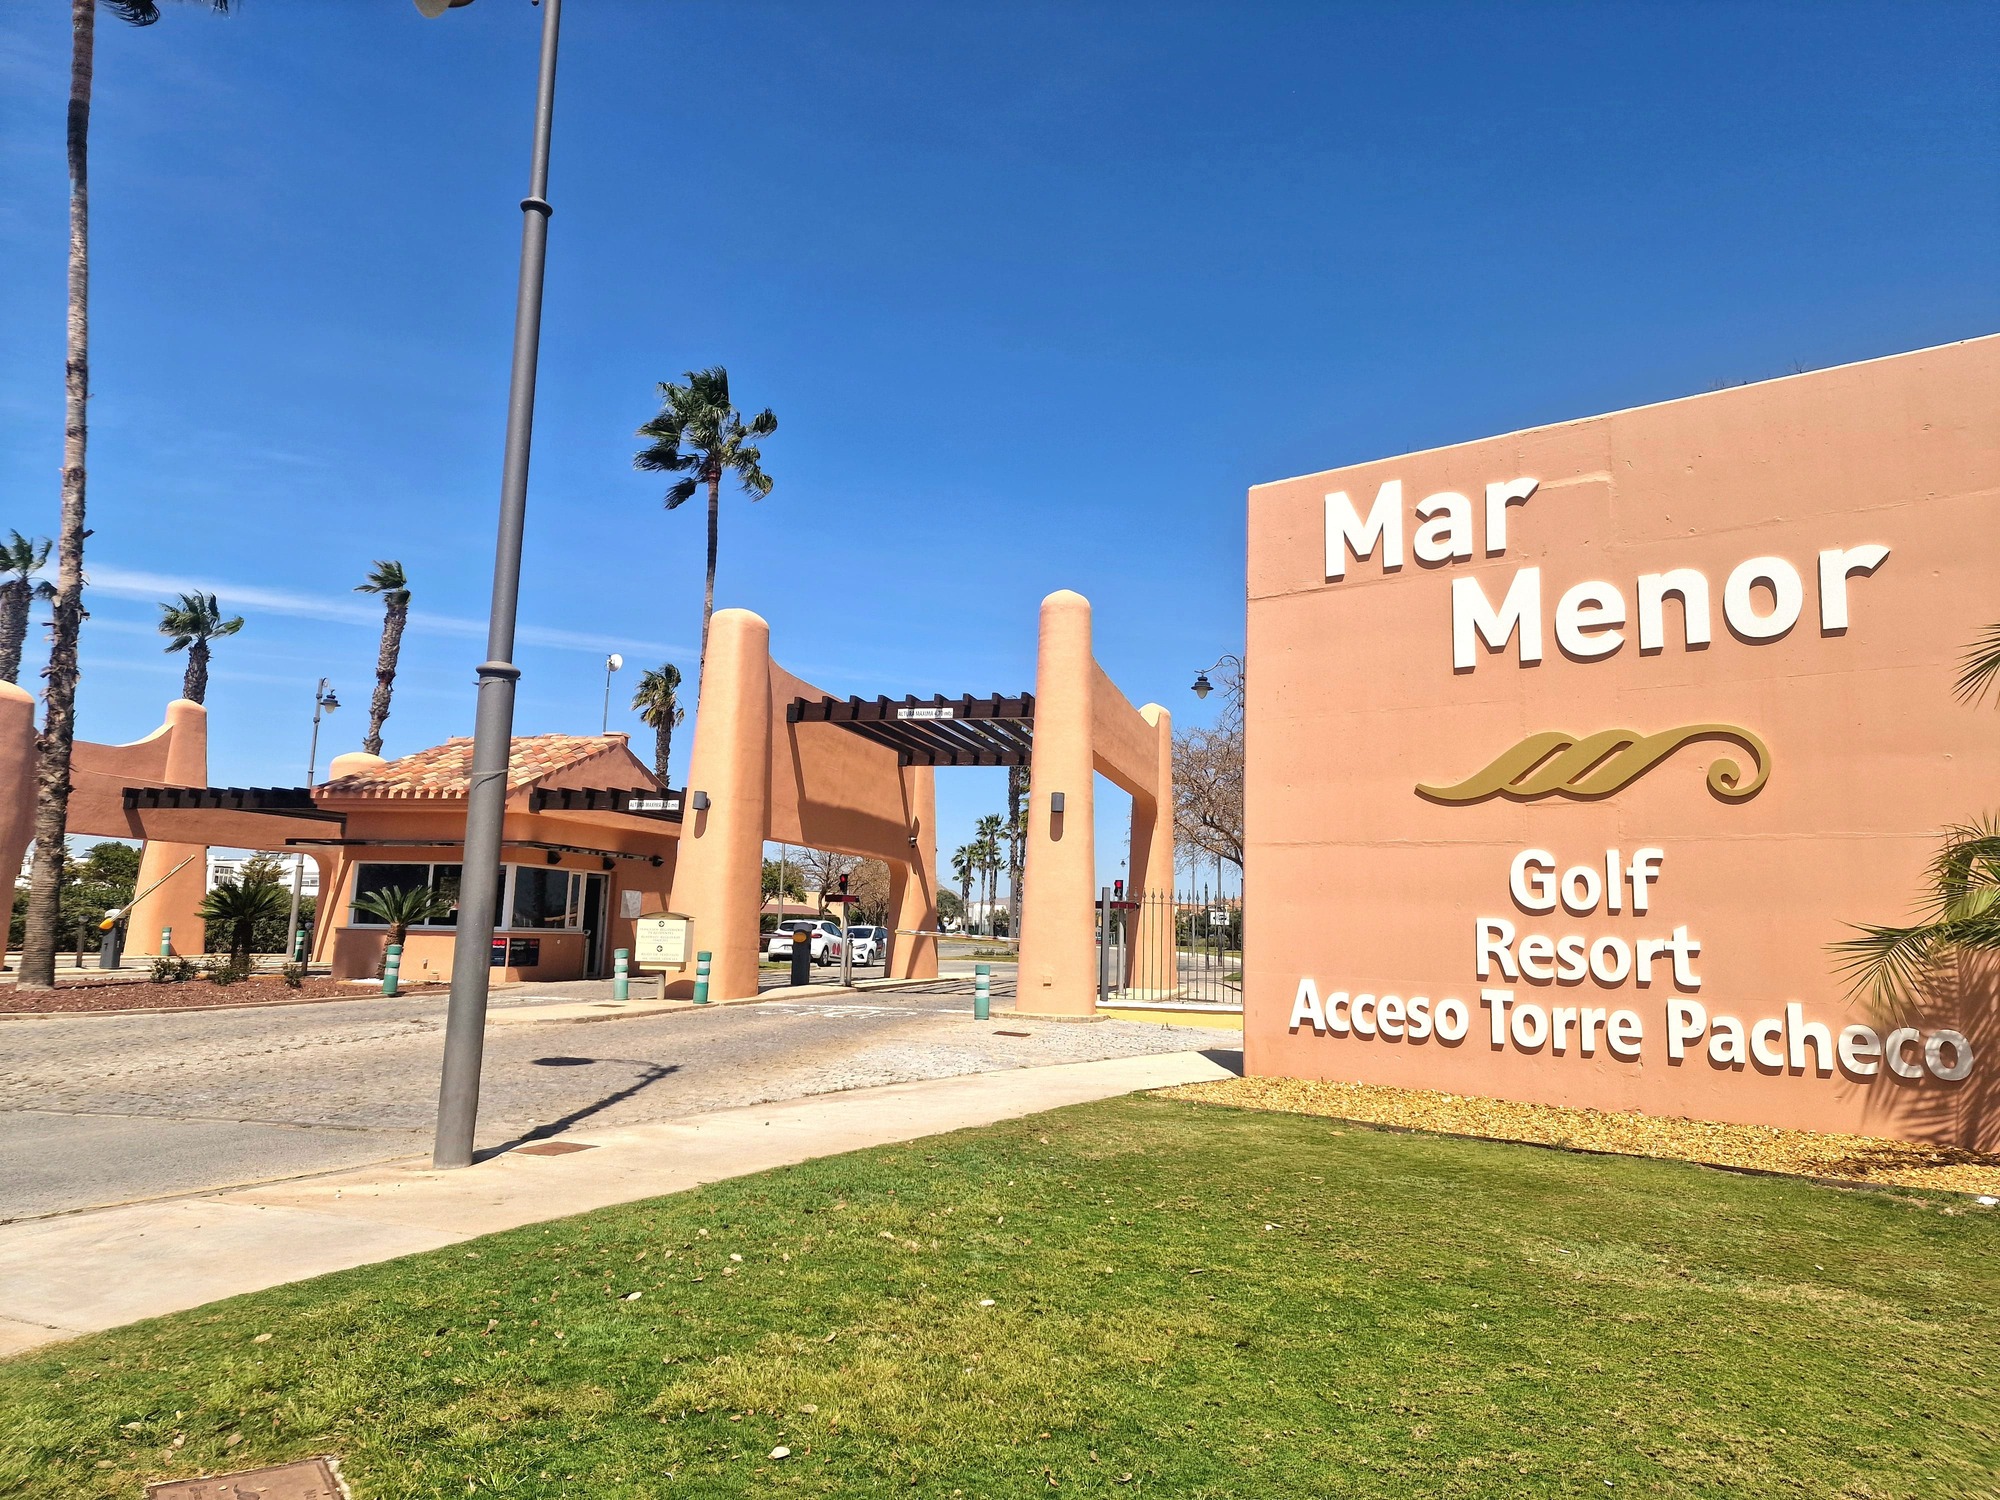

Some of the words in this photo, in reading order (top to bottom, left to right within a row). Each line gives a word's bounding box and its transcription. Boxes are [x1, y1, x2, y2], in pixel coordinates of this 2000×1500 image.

[1325, 477, 1540, 577] Mar
[1452, 544, 1891, 669] Menor
[1511, 849, 1665, 911] Golf
[1476, 917, 1702, 986] Resort
[1290, 978, 1470, 1042] Acceso
[1482, 989, 1643, 1056] Torre
[1667, 999, 1975, 1081] Pacheco
